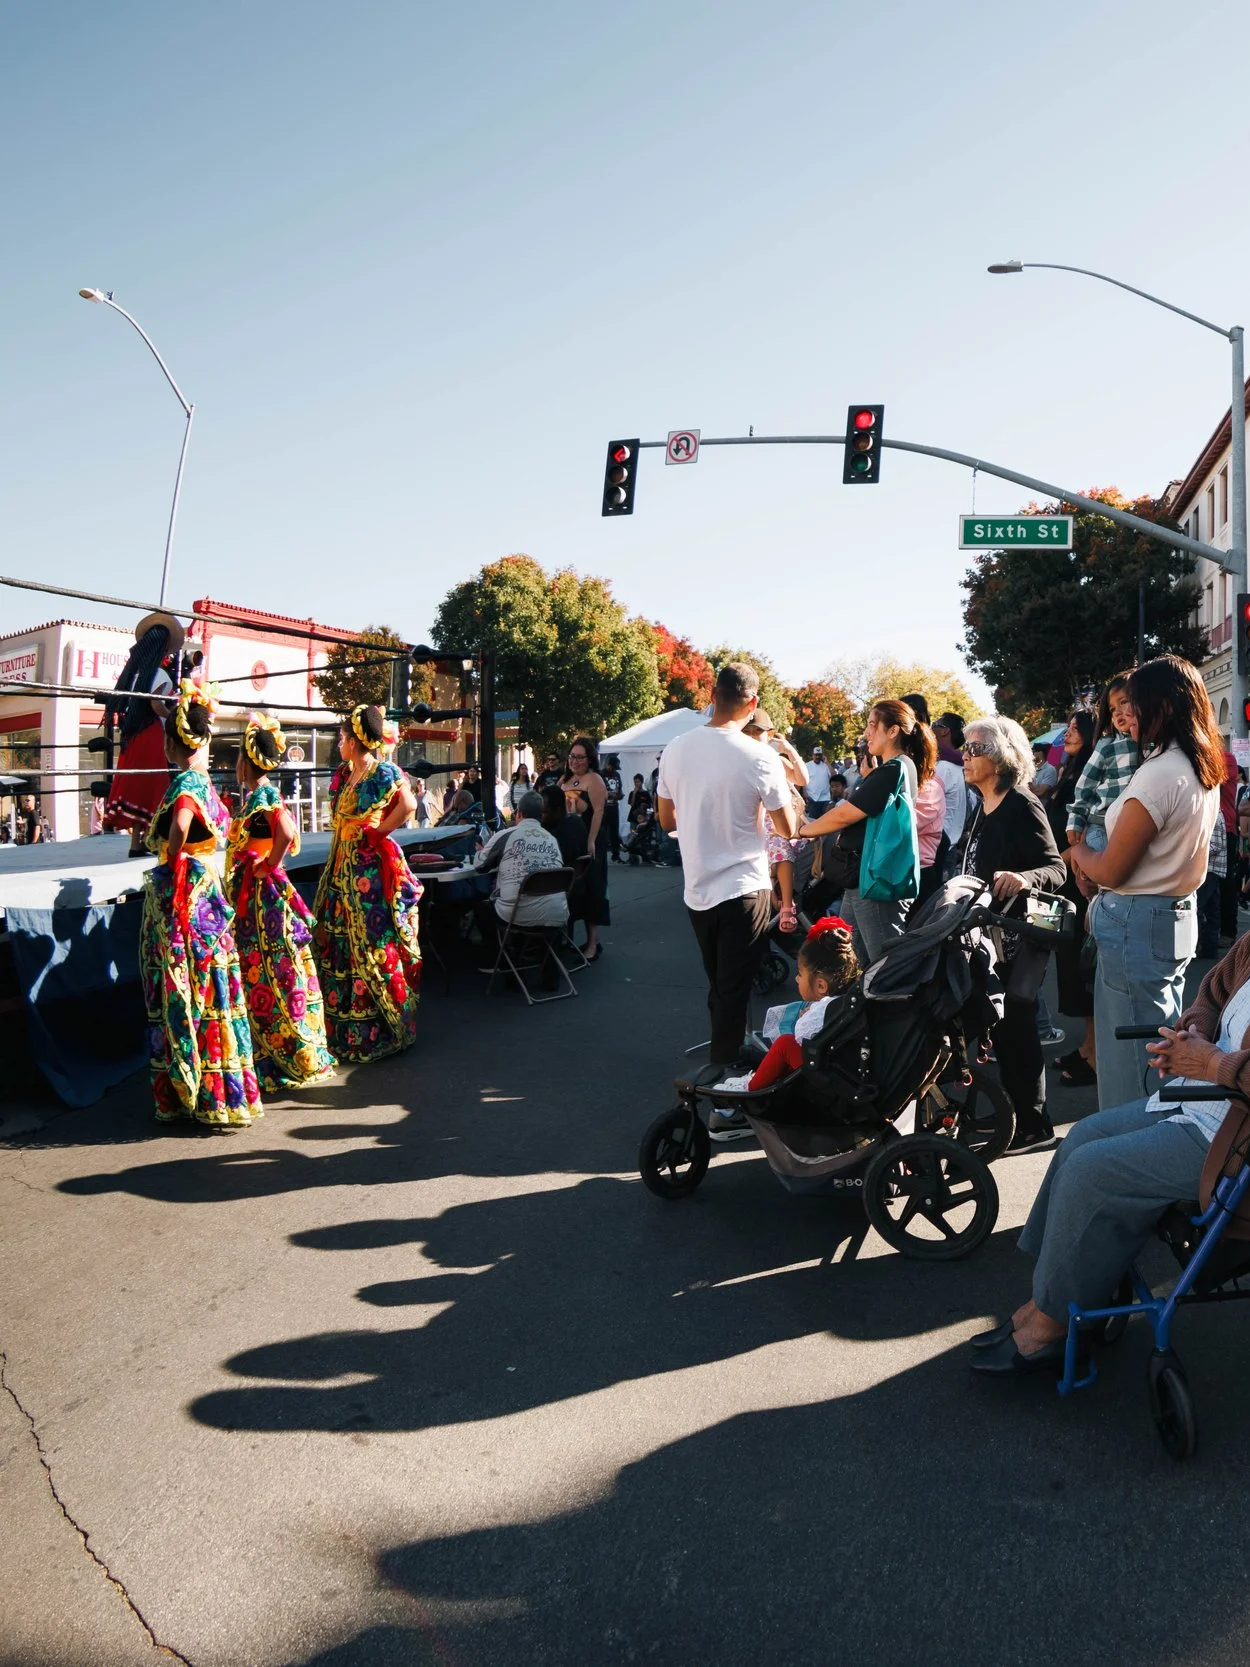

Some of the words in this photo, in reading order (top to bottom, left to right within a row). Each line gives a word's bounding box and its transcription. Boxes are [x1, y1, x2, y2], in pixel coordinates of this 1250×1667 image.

[973, 523, 1027, 538] Sixth
[1037, 524, 1059, 538] St
[102, 652, 129, 667] HOUS
